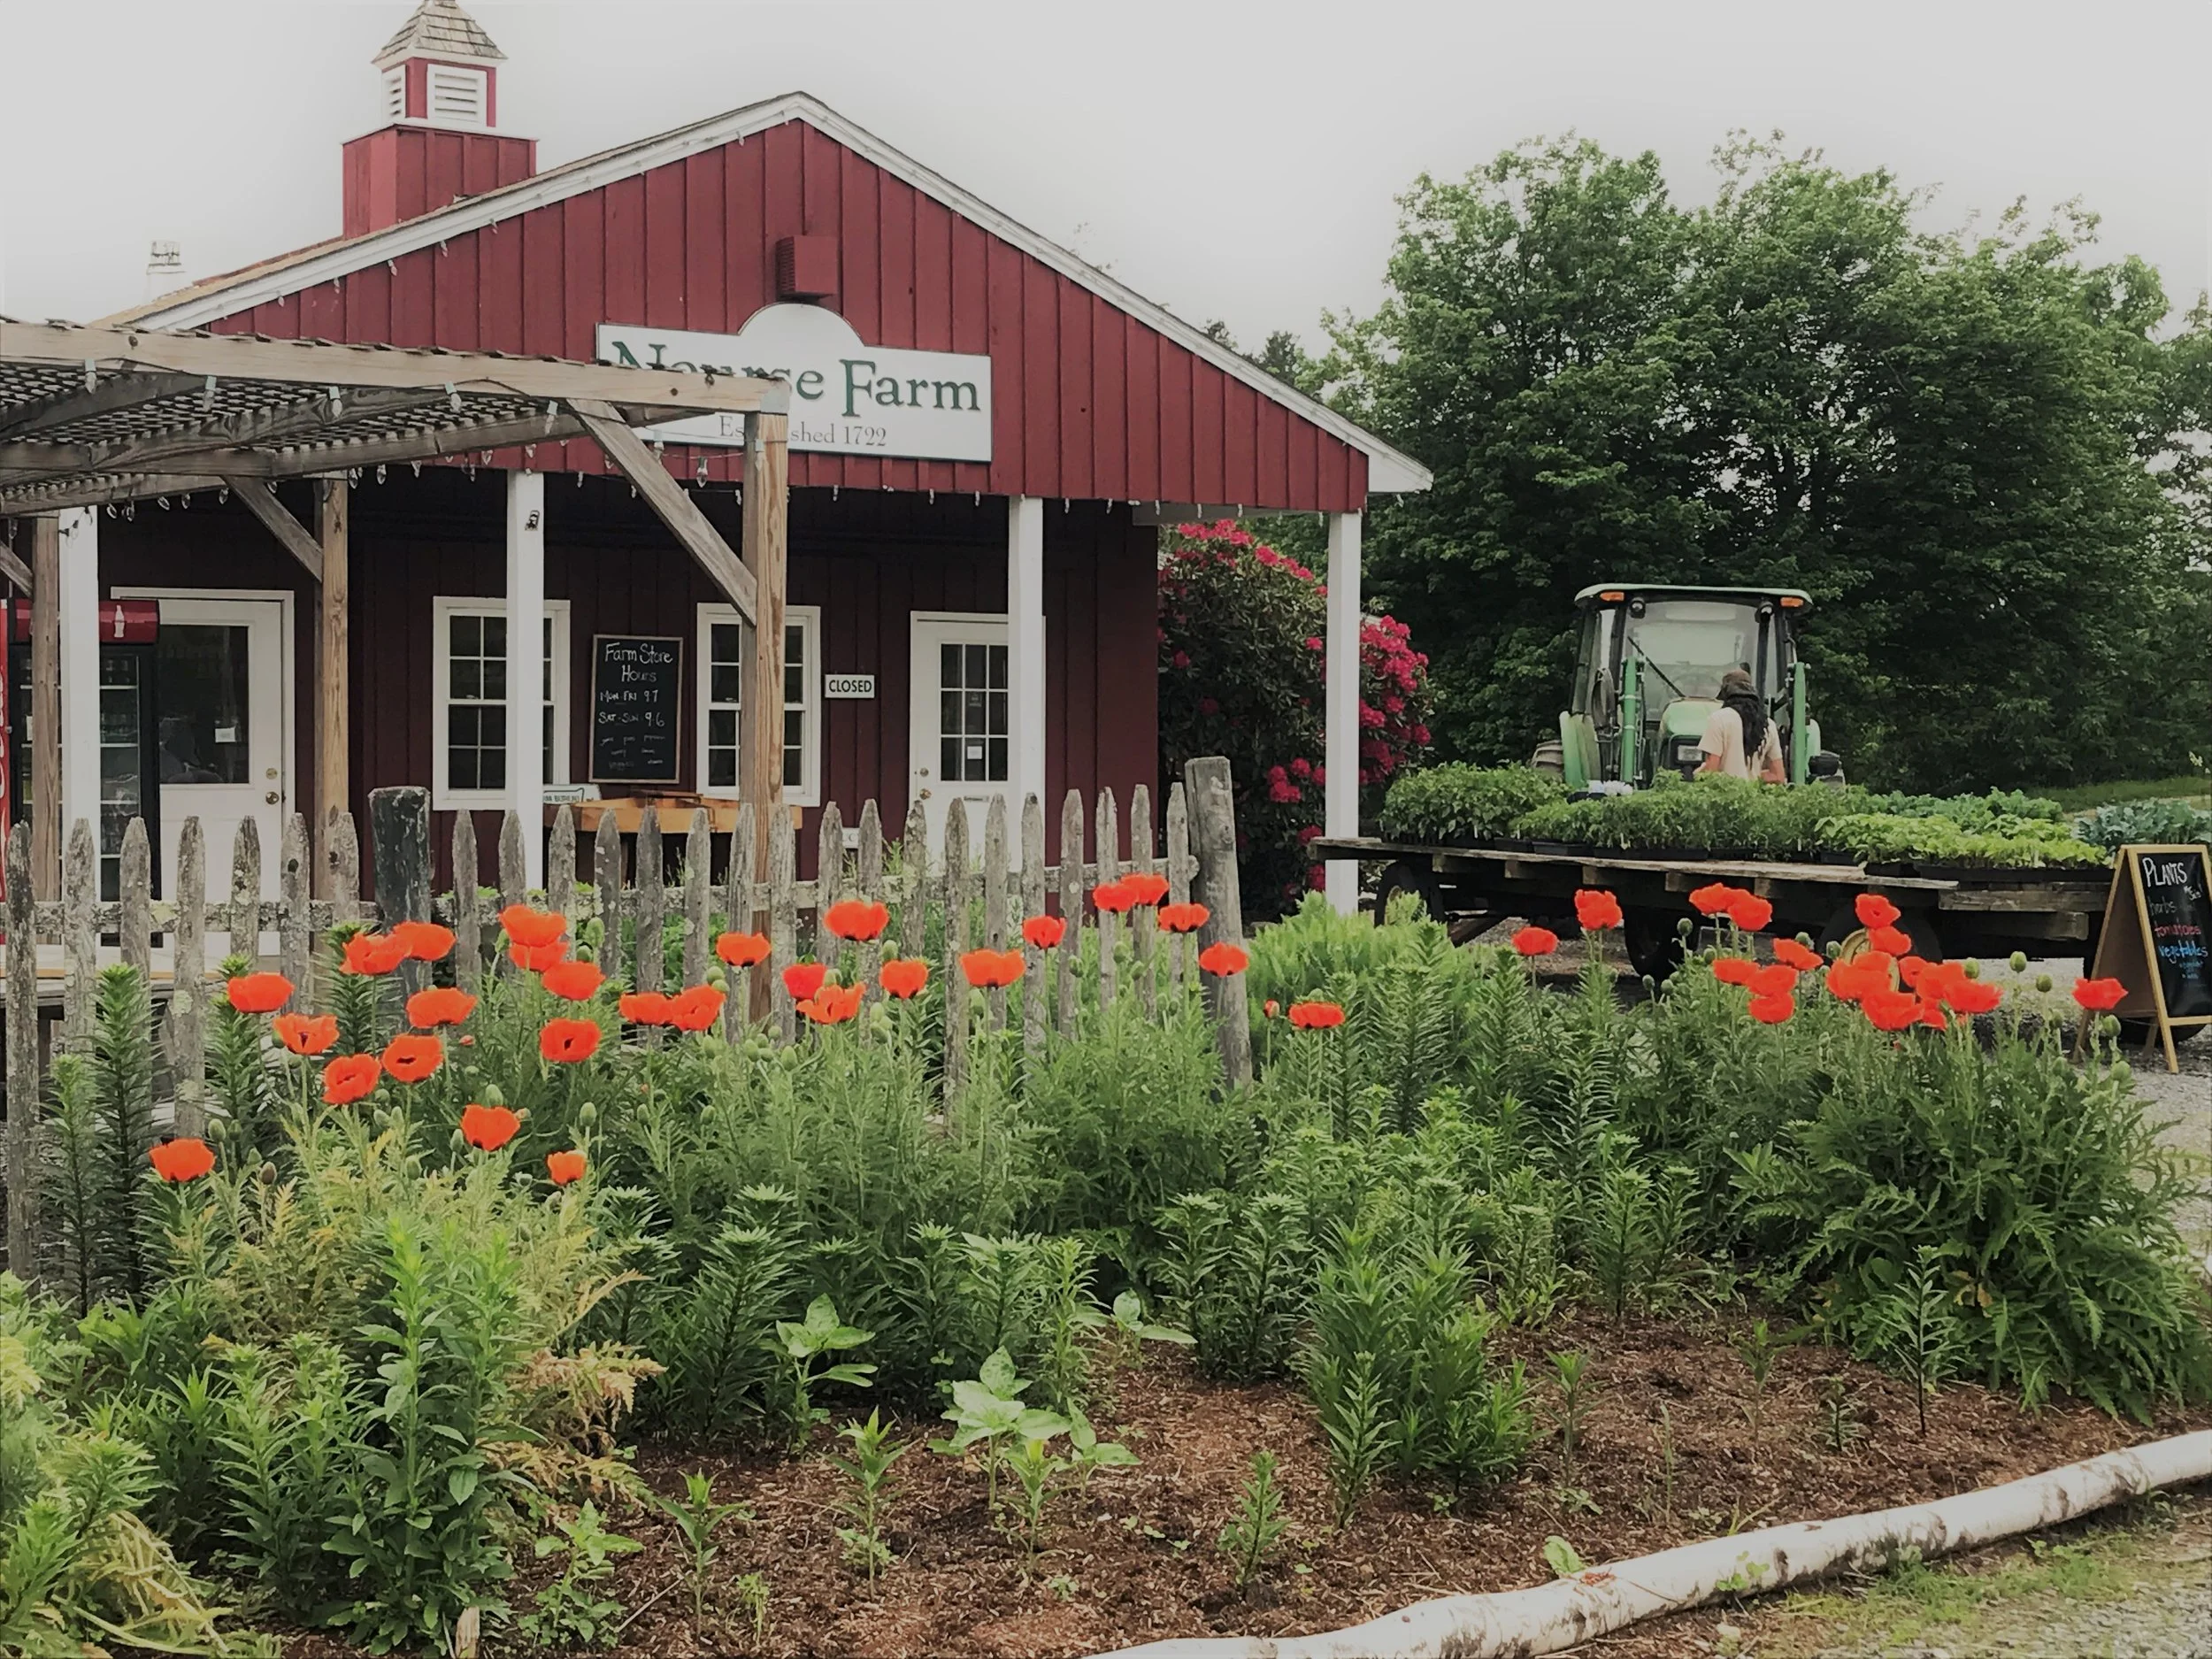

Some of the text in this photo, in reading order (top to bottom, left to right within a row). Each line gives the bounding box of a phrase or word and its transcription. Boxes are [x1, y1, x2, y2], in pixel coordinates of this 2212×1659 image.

[840, 358, 981, 418] Farm
[719, 414, 887, 447] Esshed 1722
[605, 642, 673, 664] Farm Store
[621, 664, 657, 682] Hours
[829, 680, 872, 693] CLOSED
[2142, 857, 2187, 887] PLANTS
[2159, 940, 2208, 964] vegetables
